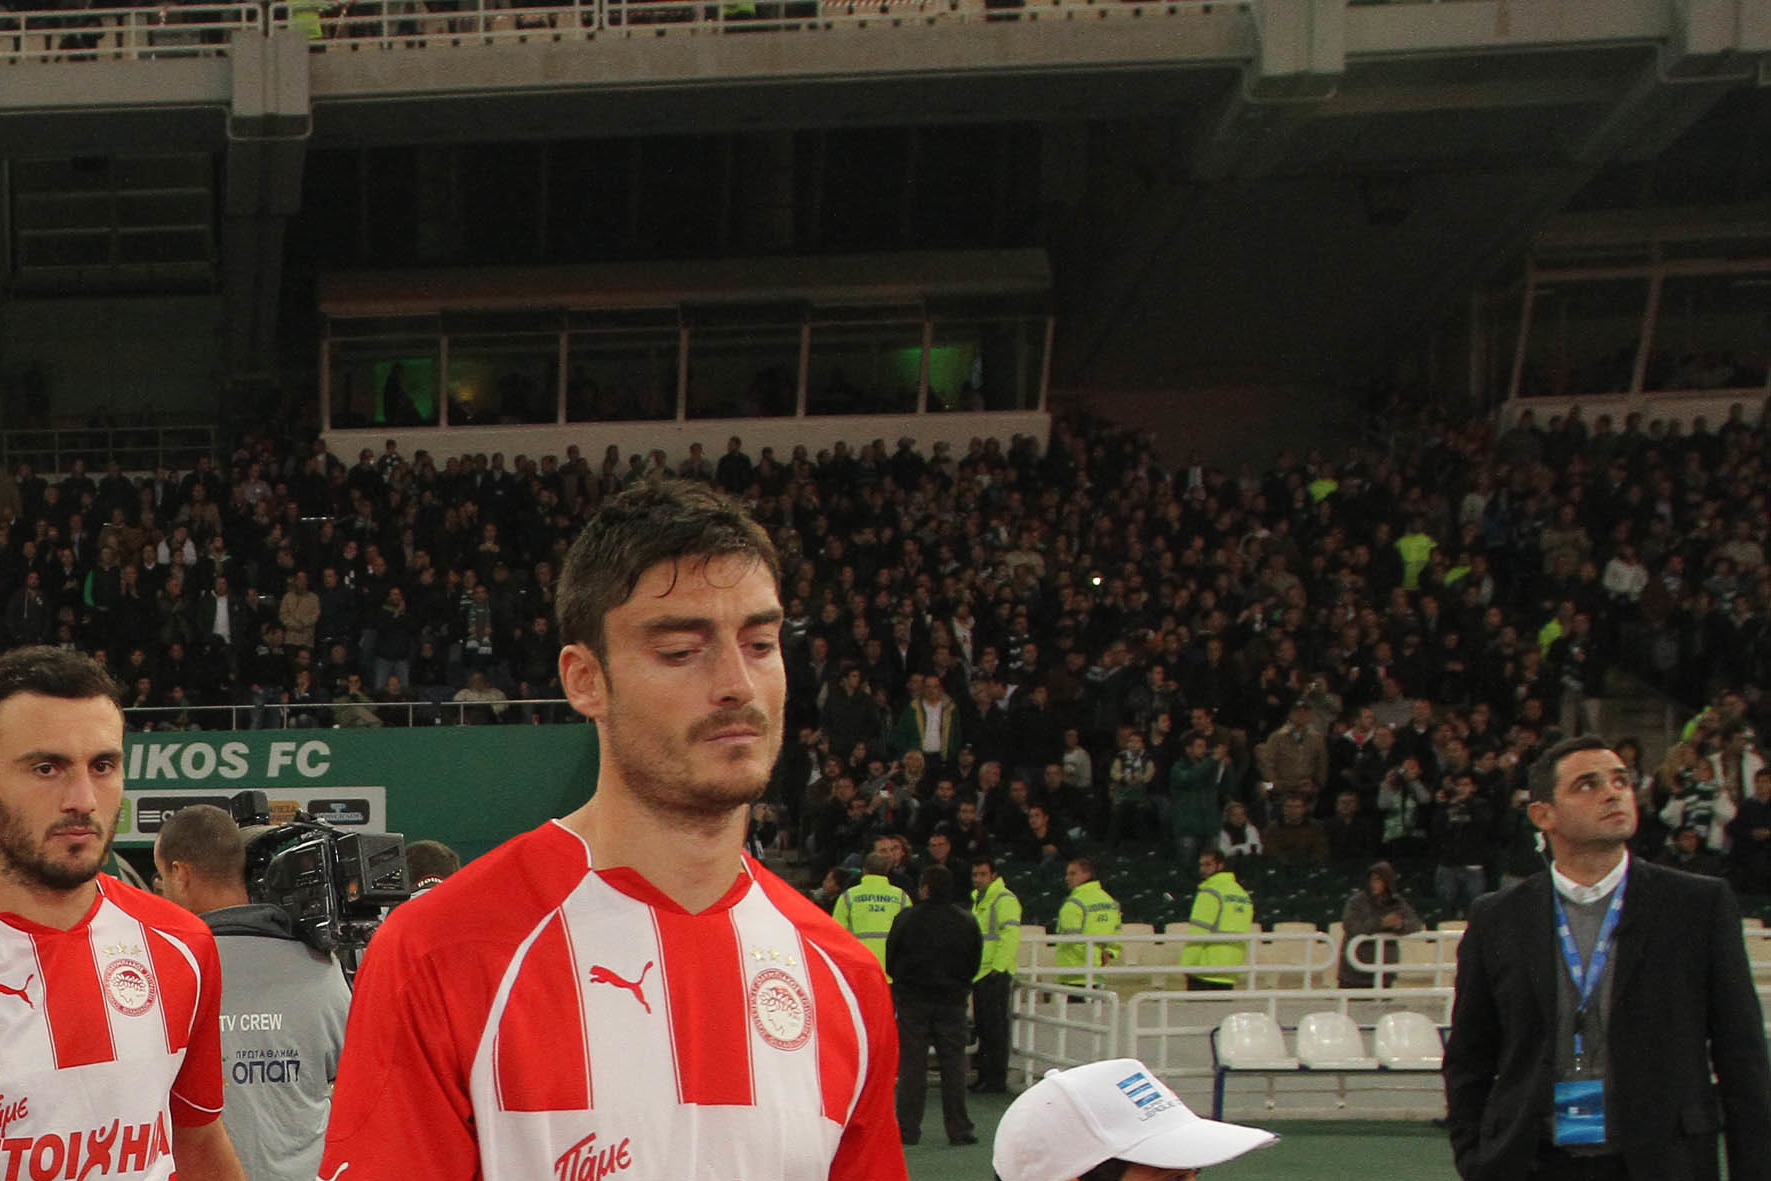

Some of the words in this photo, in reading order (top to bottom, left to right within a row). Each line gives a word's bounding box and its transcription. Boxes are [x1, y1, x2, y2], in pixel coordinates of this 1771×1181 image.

[267, 740, 331, 778] FC
[219, 1014, 236, 1032] TV
[240, 1013, 282, 1031] CREW
